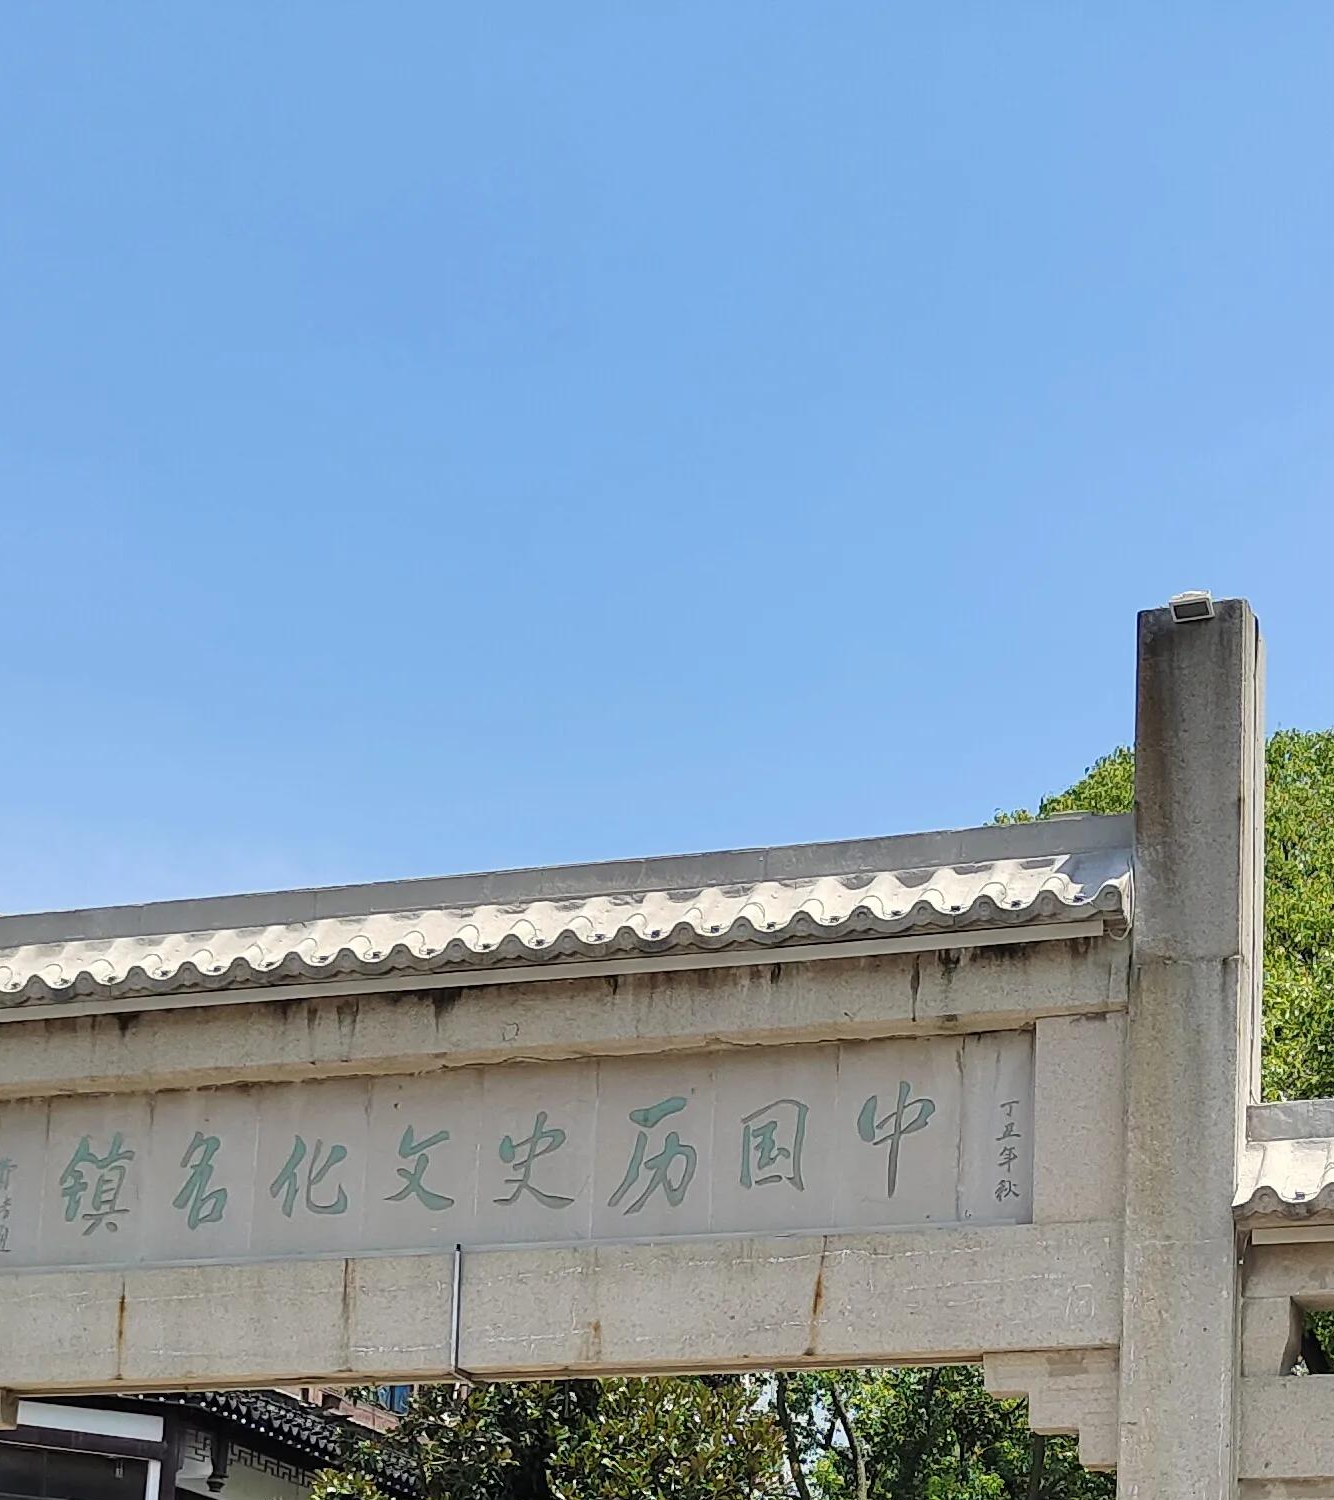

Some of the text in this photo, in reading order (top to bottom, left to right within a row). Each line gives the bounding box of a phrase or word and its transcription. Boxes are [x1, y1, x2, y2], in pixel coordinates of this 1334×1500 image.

[59, 1080, 936, 1236] 中国历史文化名镇
